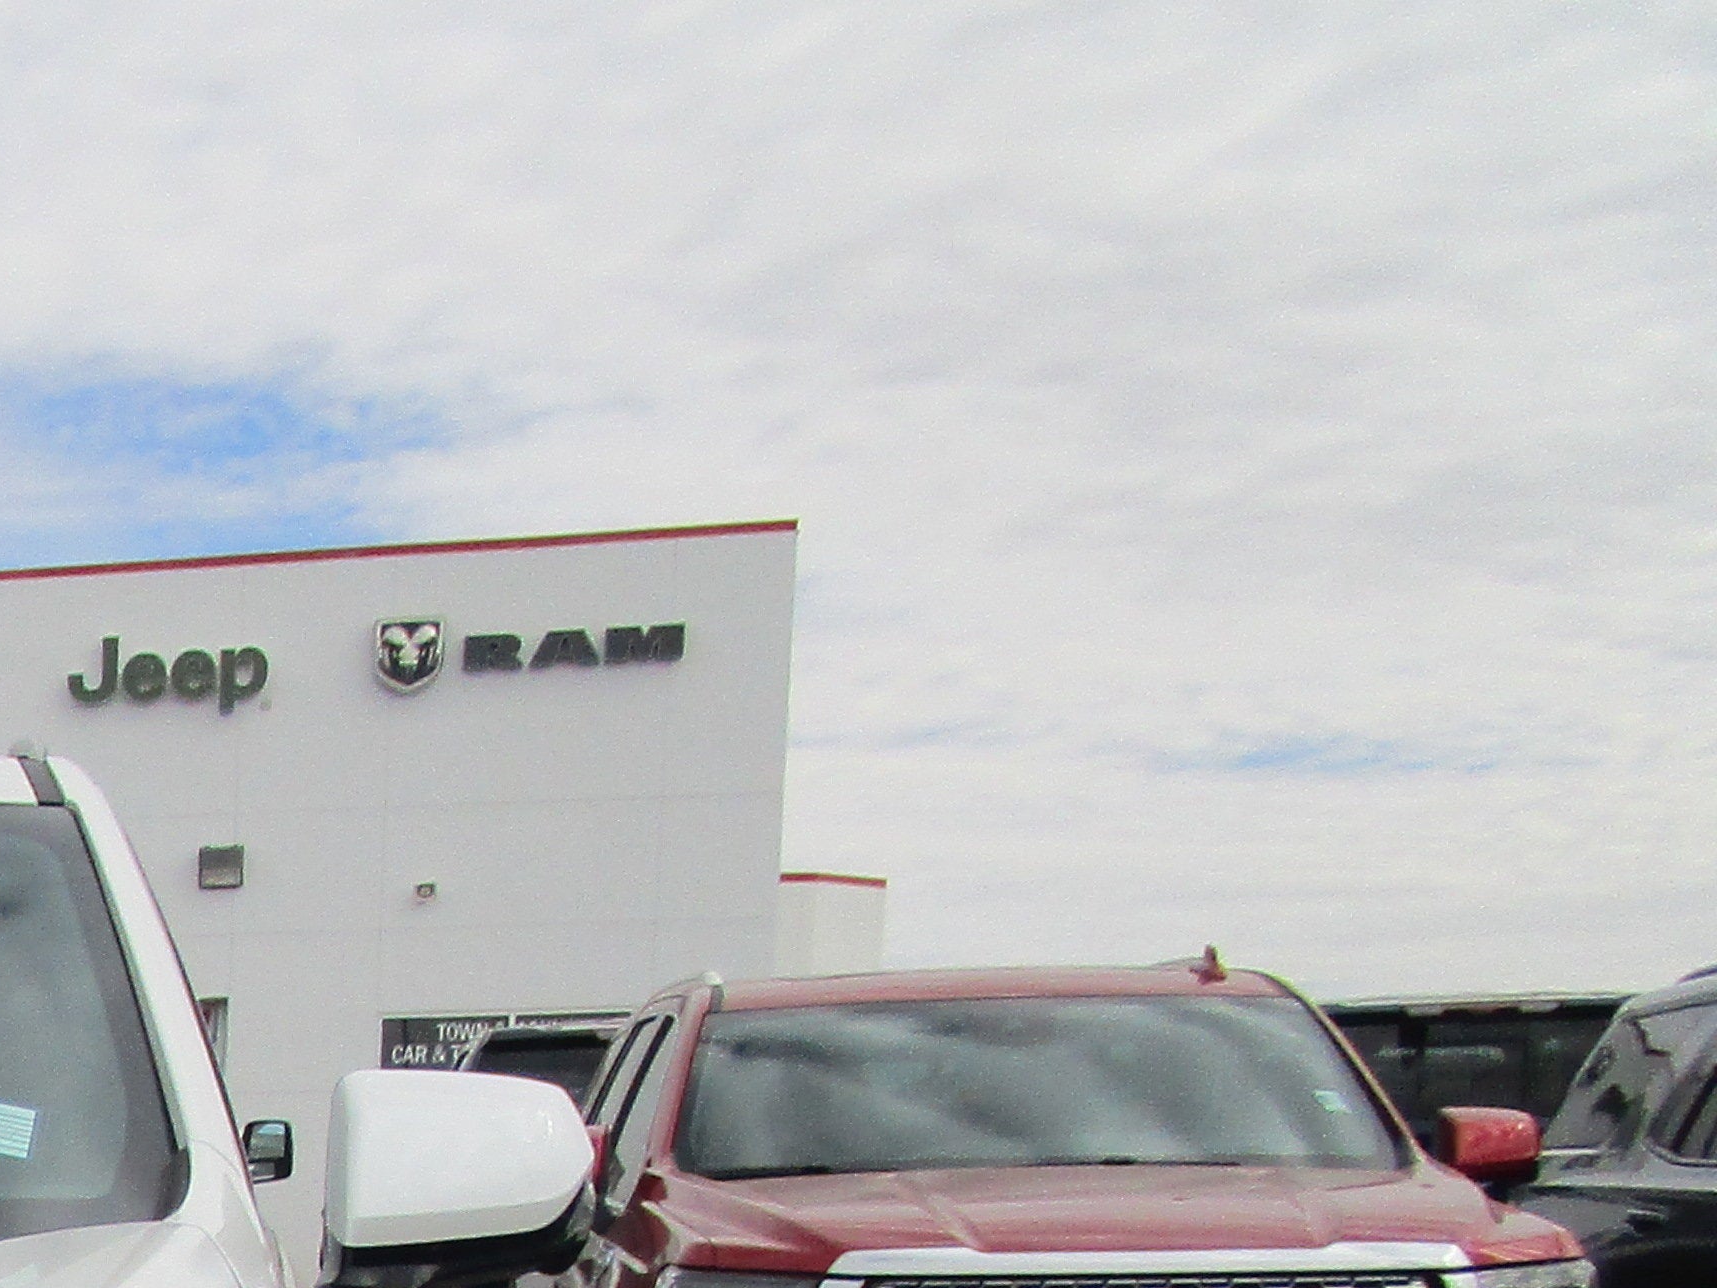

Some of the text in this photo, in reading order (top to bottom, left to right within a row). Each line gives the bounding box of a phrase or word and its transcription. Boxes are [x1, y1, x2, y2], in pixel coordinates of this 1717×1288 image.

[462, 622, 686, 673] RAM
[68, 635, 270, 716] Jeep
[391, 1044, 428, 1064] CAR
